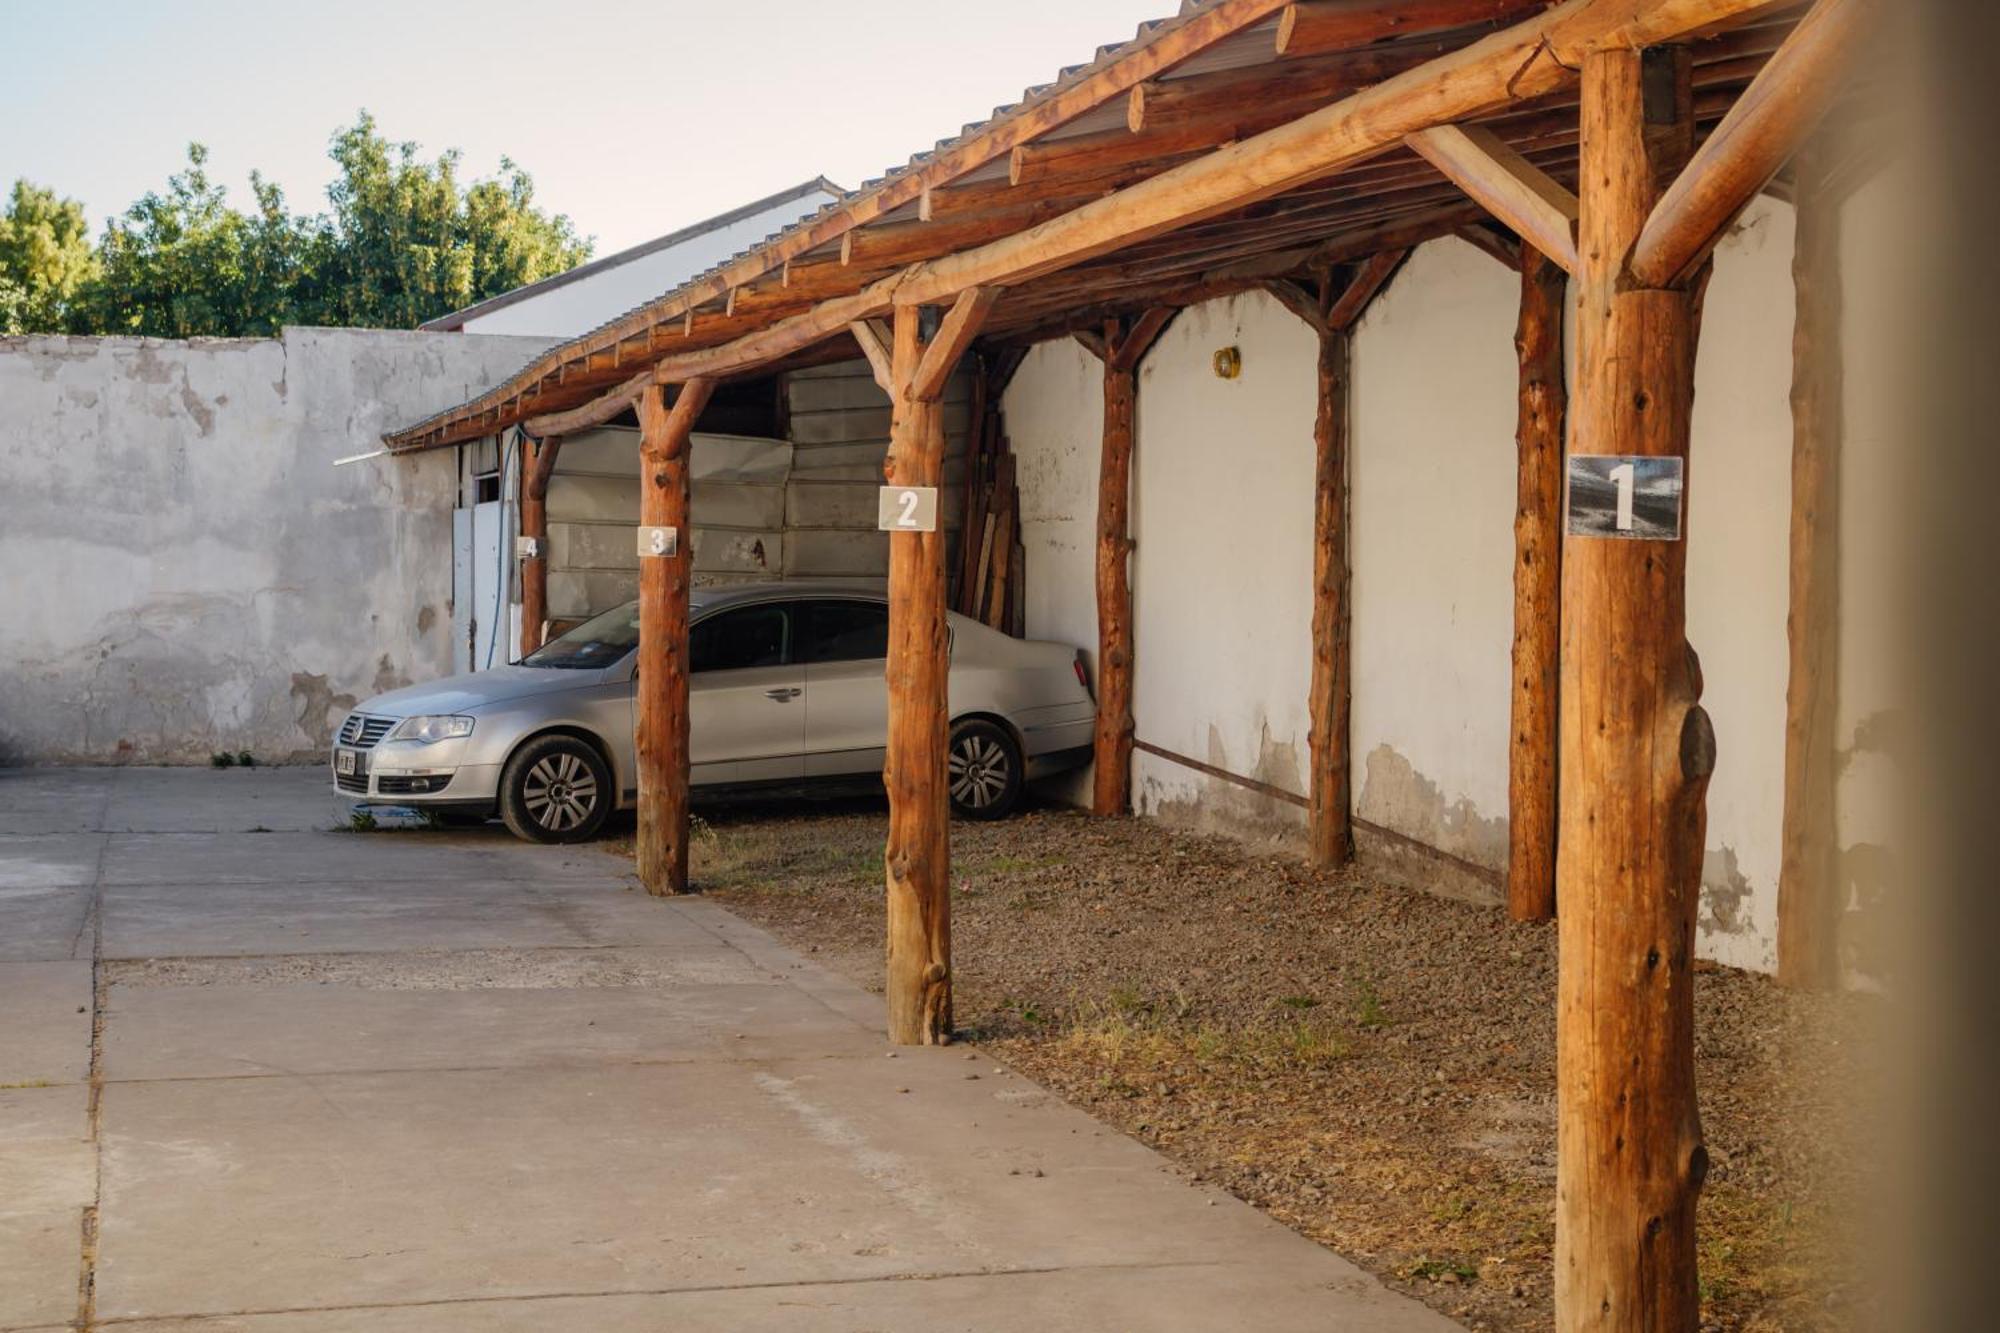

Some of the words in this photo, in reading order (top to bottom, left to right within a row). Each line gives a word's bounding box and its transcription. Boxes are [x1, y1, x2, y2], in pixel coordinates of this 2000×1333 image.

[898, 491, 918, 526] 2
[1609, 464, 1634, 530] 1
[527, 538, 537, 557] 4
[651, 529, 664, 553] 3
